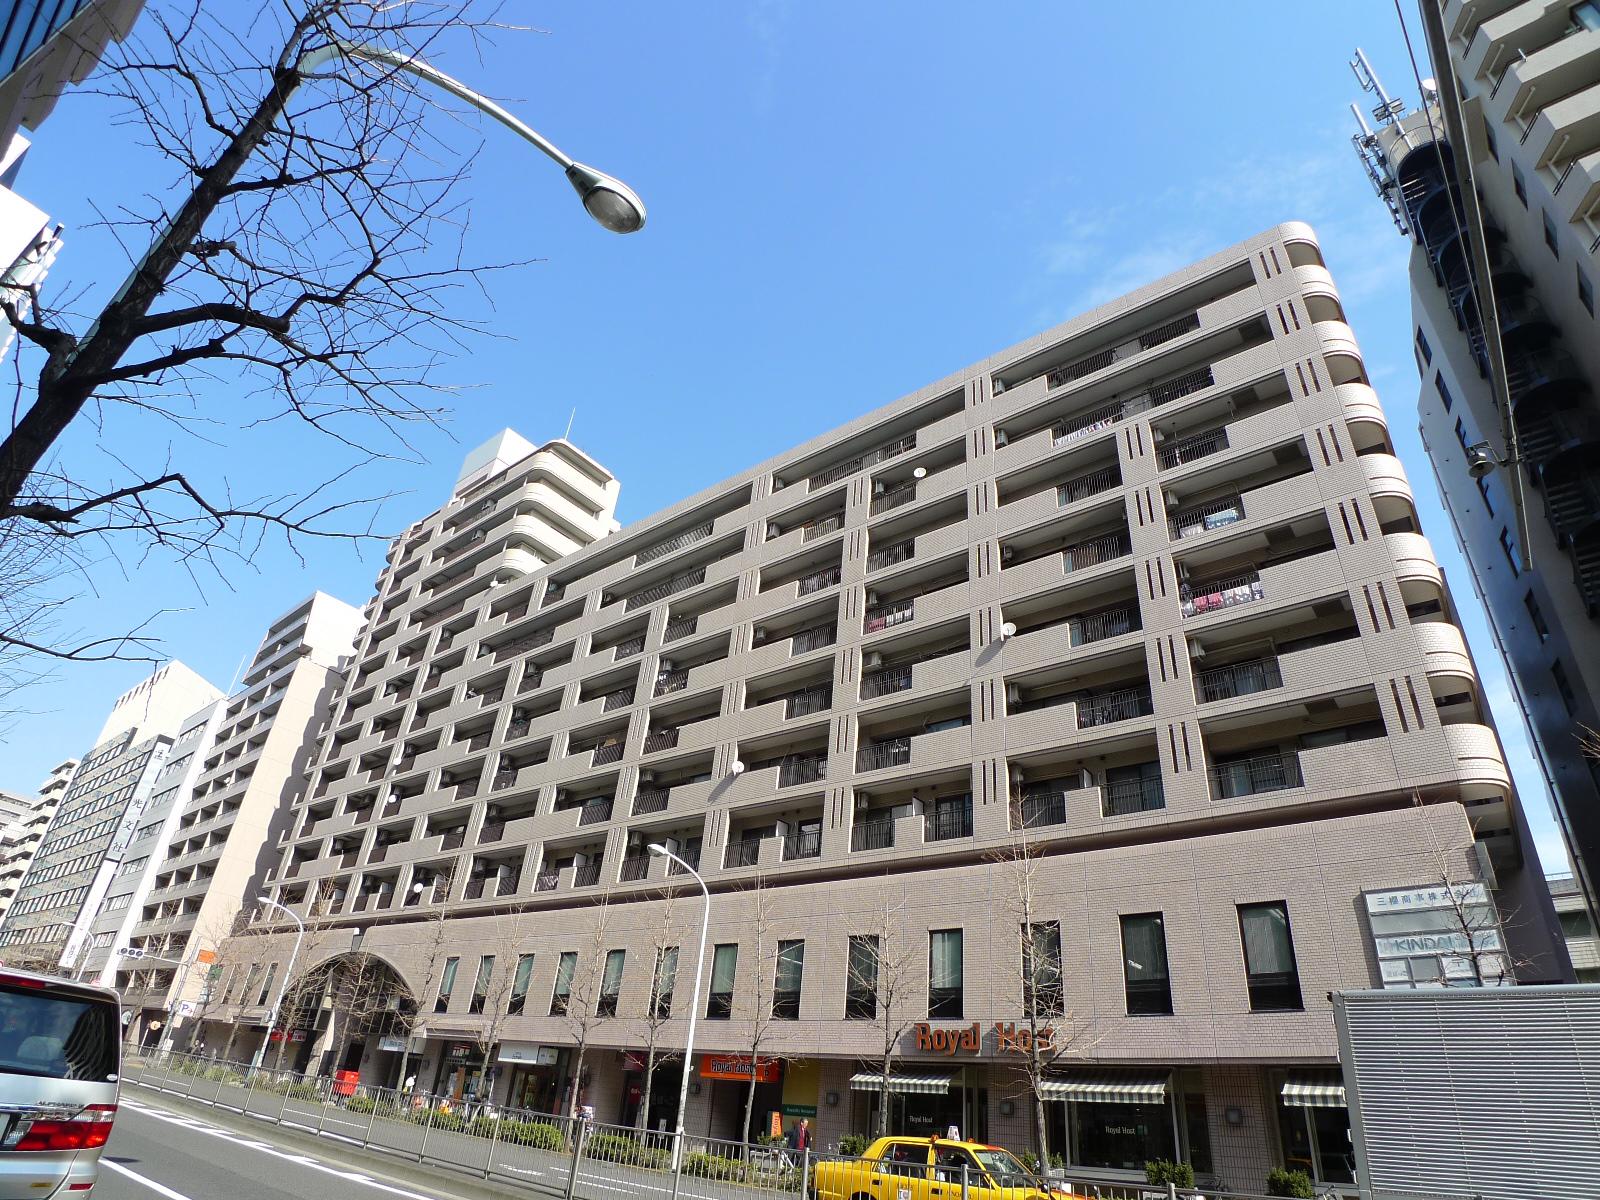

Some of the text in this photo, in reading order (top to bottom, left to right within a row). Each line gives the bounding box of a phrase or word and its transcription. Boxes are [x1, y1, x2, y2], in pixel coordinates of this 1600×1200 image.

[111, 798, 144, 853] 光文社
[914, 1022, 981, 1057] Royal
[711, 1059, 732, 1074] Royal
